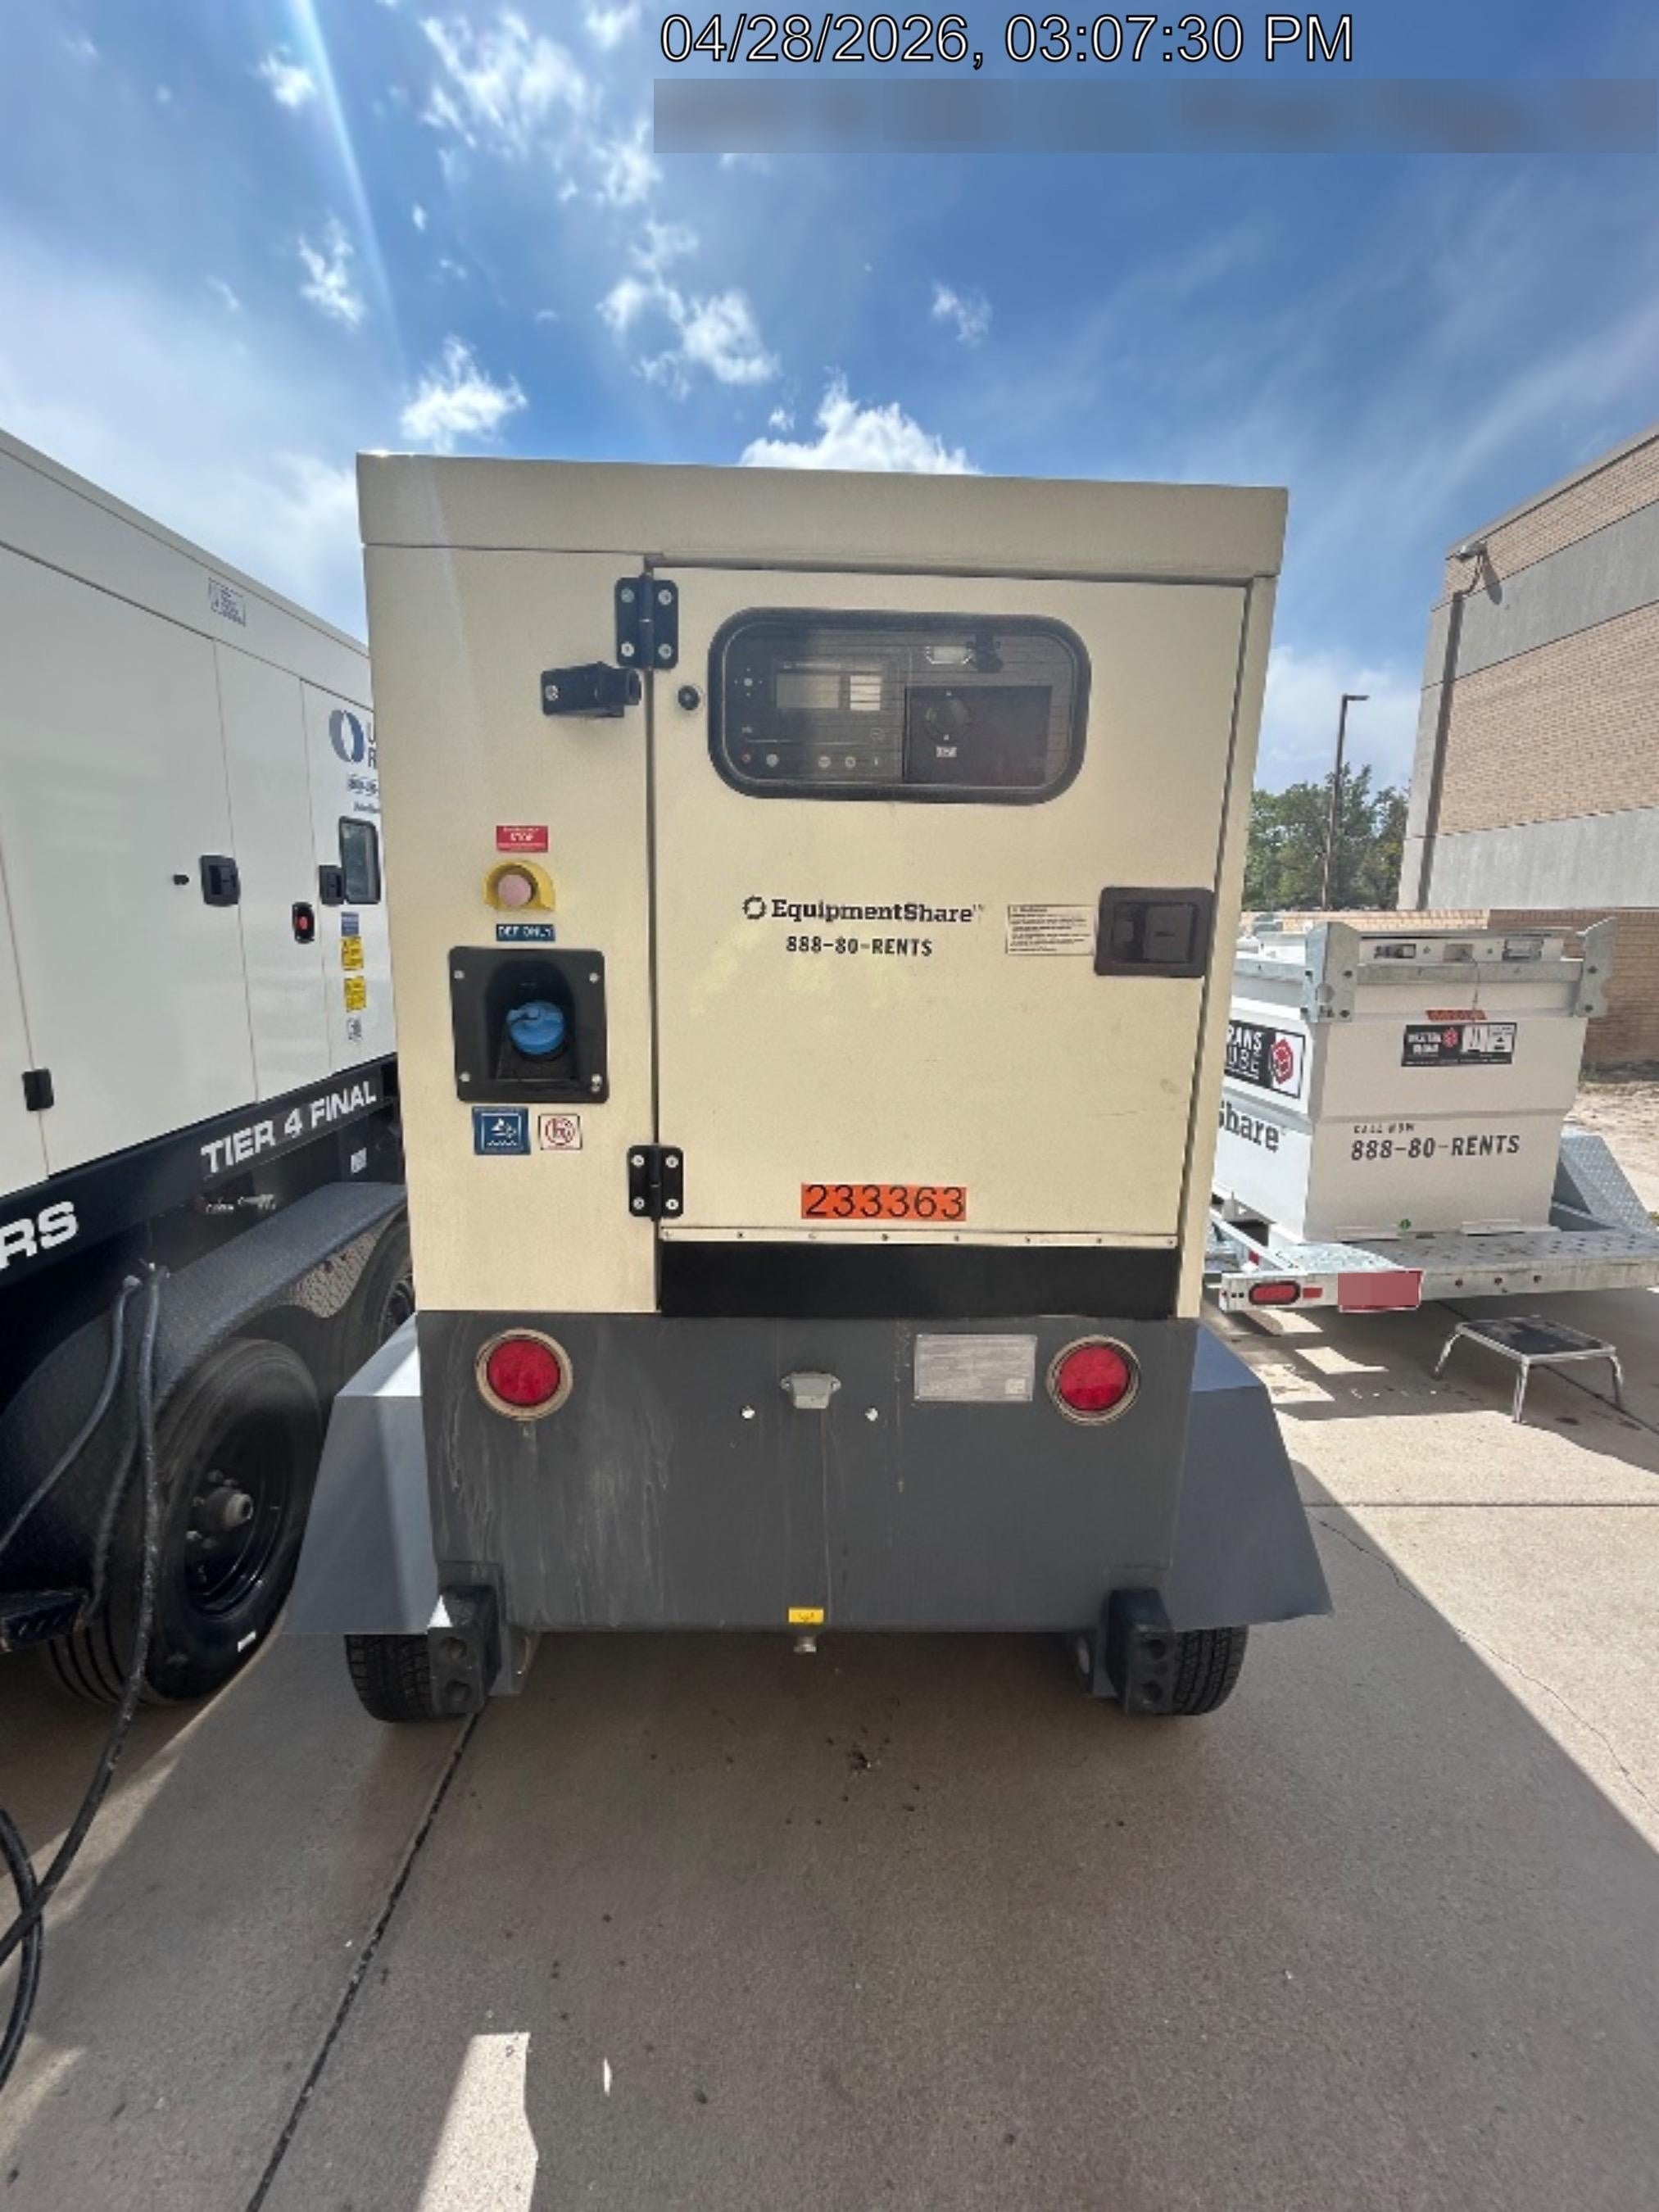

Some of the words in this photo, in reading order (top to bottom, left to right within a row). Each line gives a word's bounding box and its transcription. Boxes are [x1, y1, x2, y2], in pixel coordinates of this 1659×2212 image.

[771, 898, 973, 923] EquipmentShare
[786, 936, 934, 957] 888-80-RENTS
[200, 1120, 276, 1173] TIER
[284, 1108, 303, 1138] 4
[310, 1081, 377, 1129] FINAL
[1351, 1135, 1521, 1161] 888-80-RENTS
[805, 1184, 964, 1219] 233363
